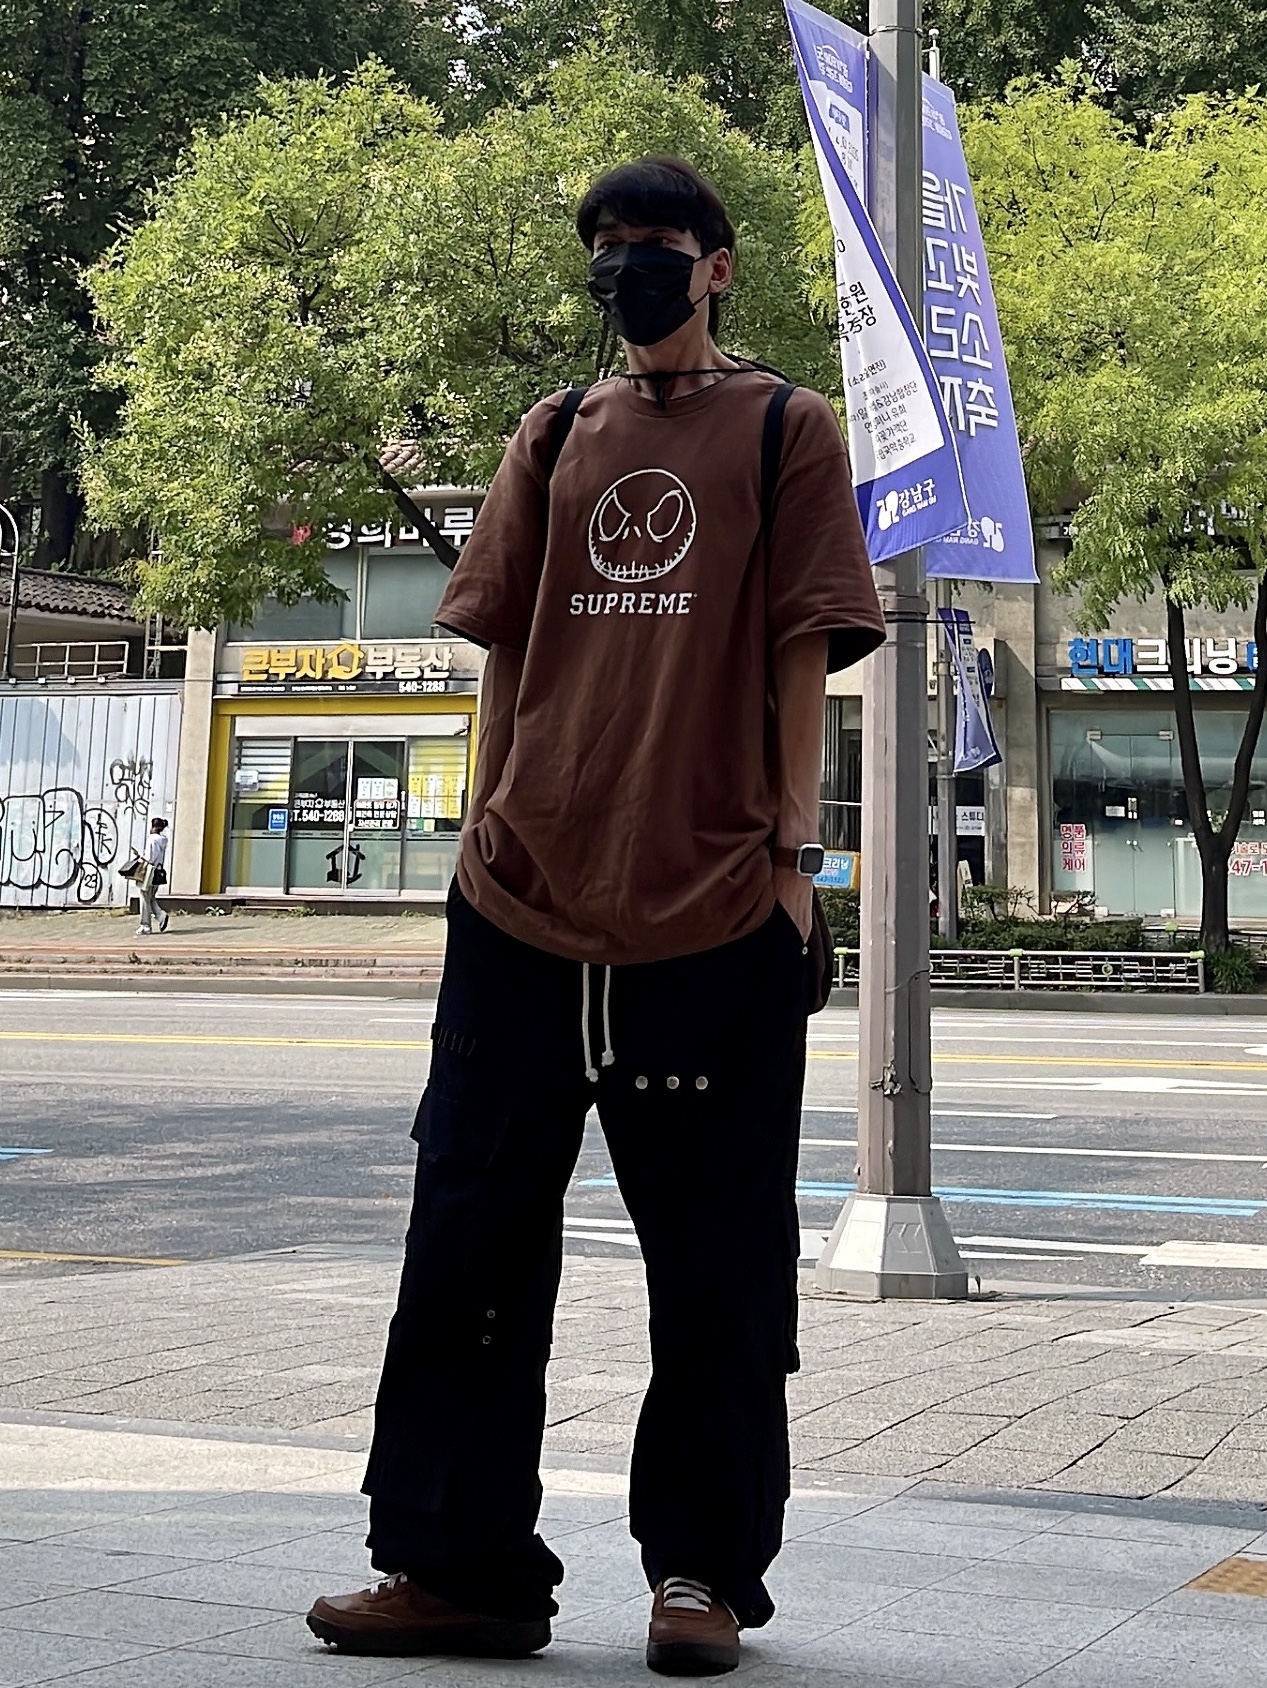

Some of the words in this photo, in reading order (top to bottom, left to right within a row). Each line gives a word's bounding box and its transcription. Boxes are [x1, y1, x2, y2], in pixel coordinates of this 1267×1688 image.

[898, 478, 936, 509] 강남구
[569, 592, 693, 615] SUPREME
[243, 647, 326, 681] 큰부자
[365, 646, 454, 680] 부동산
[1062, 825, 1084, 838] 명품
[1062, 842, 1085, 855] 의류
[1062, 858, 1085, 871] 케어
